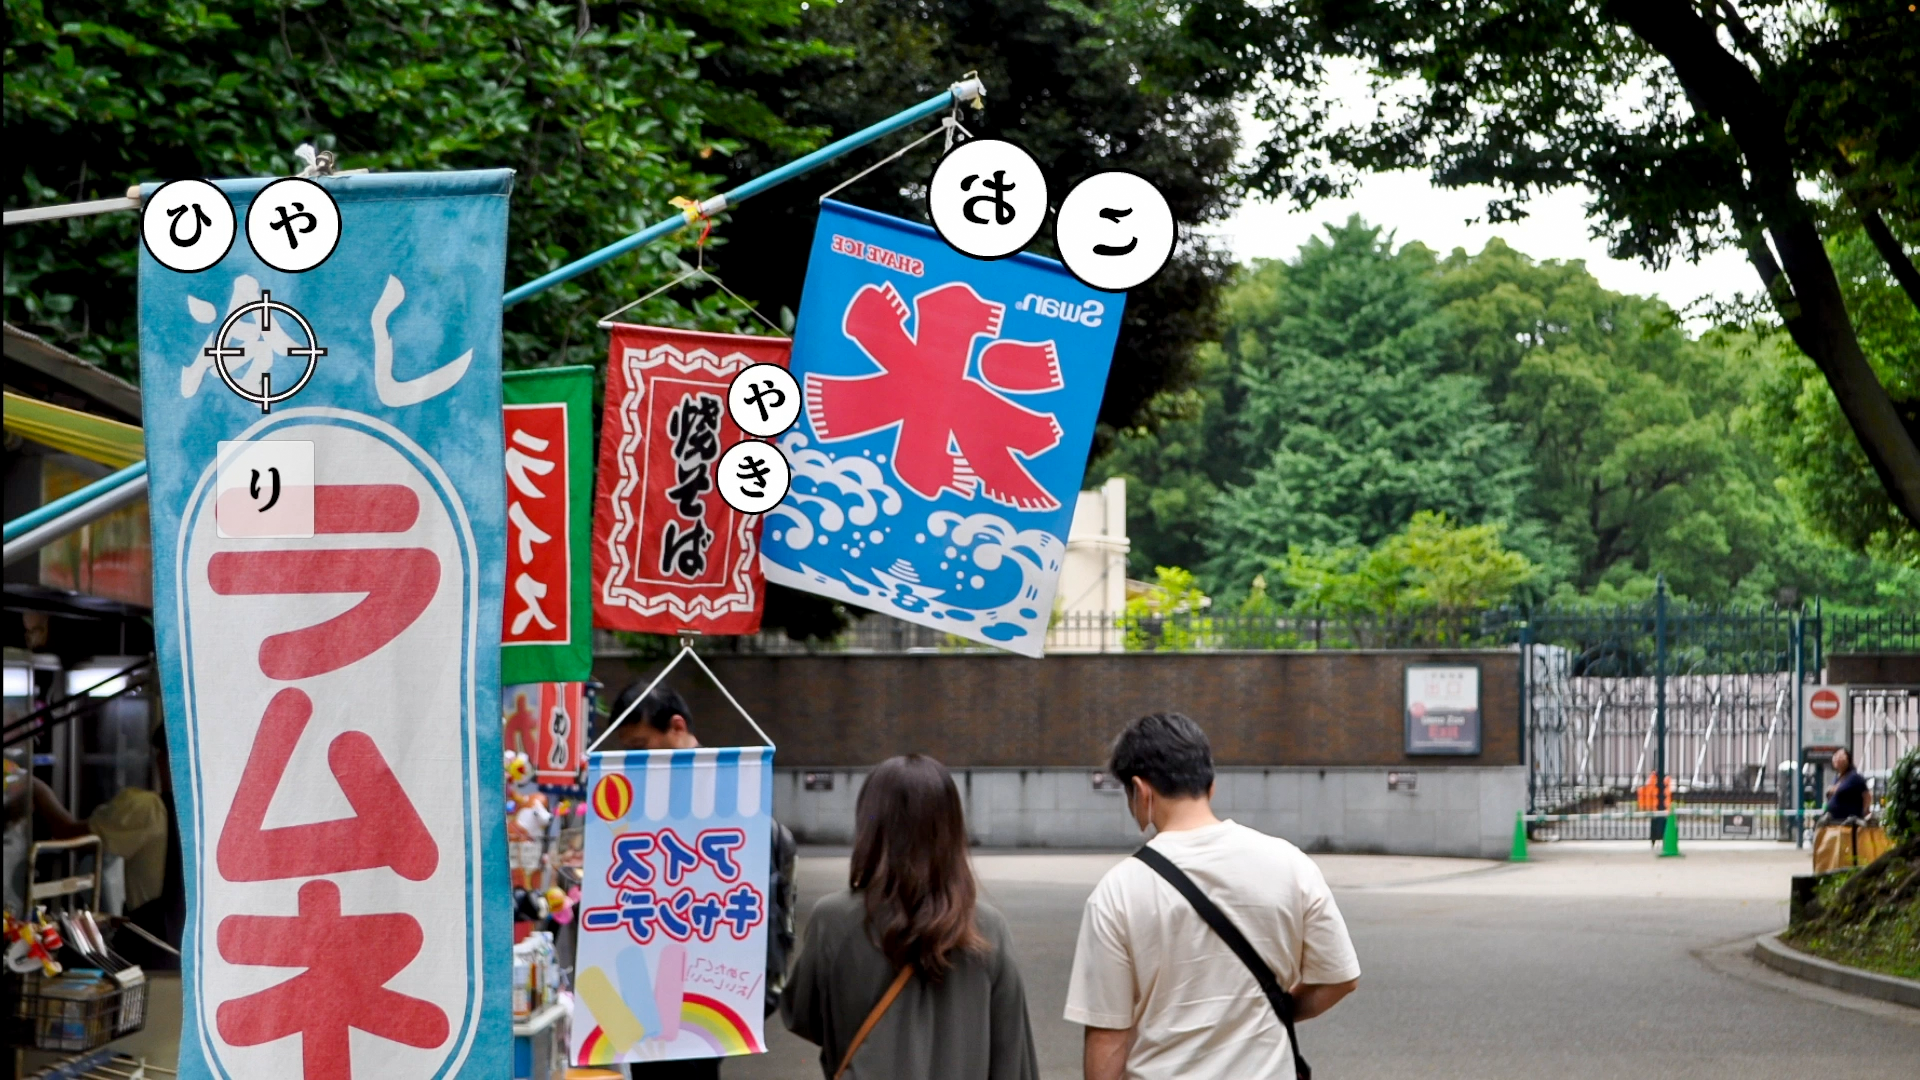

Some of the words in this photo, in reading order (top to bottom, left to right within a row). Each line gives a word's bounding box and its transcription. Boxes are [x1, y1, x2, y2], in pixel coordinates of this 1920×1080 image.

[180, 273, 474, 408] 冷し
[661, 393, 724, 578] 焼そば
[207, 484, 450, 1080] ラムネ
